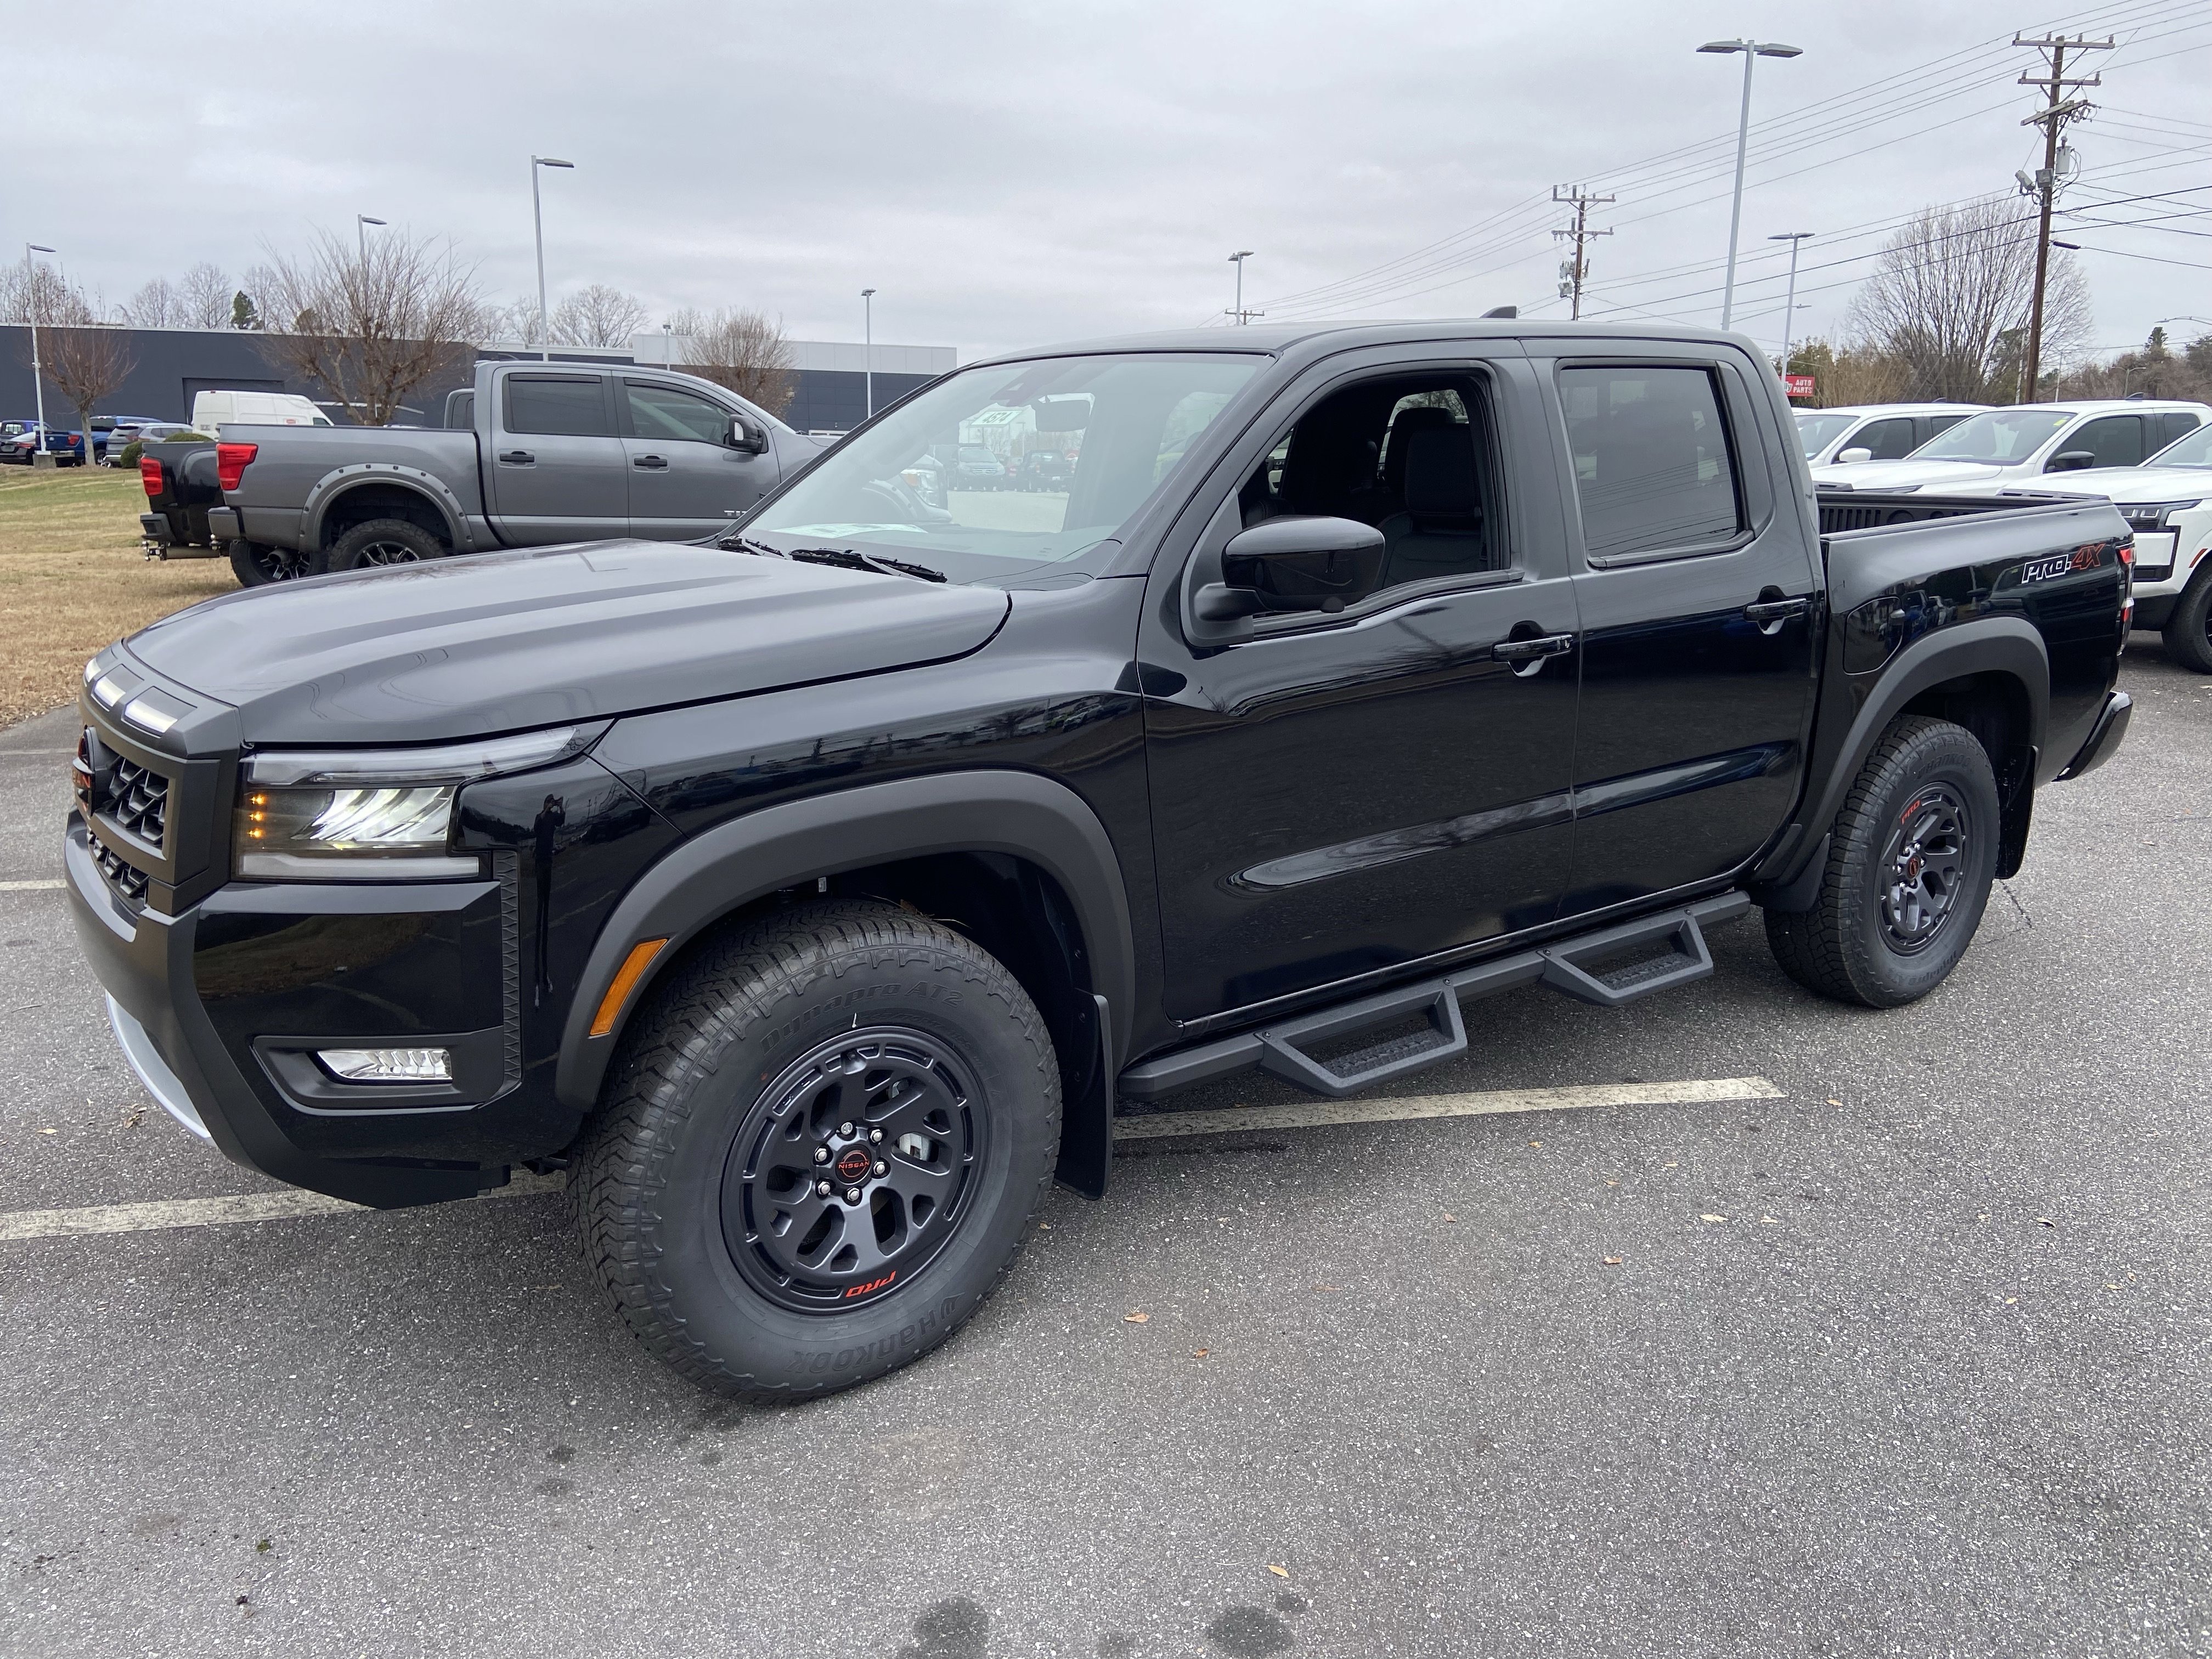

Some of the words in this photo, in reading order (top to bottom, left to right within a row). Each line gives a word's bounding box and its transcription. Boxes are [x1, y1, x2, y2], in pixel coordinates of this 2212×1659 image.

[1900, 799, 1921, 826] PRO
[759, 983, 902, 1056] Dynapro
[904, 980, 964, 1008] AT2
[838, 1159, 870, 1170] NISSAN
[845, 1269, 896, 1298] PRO
